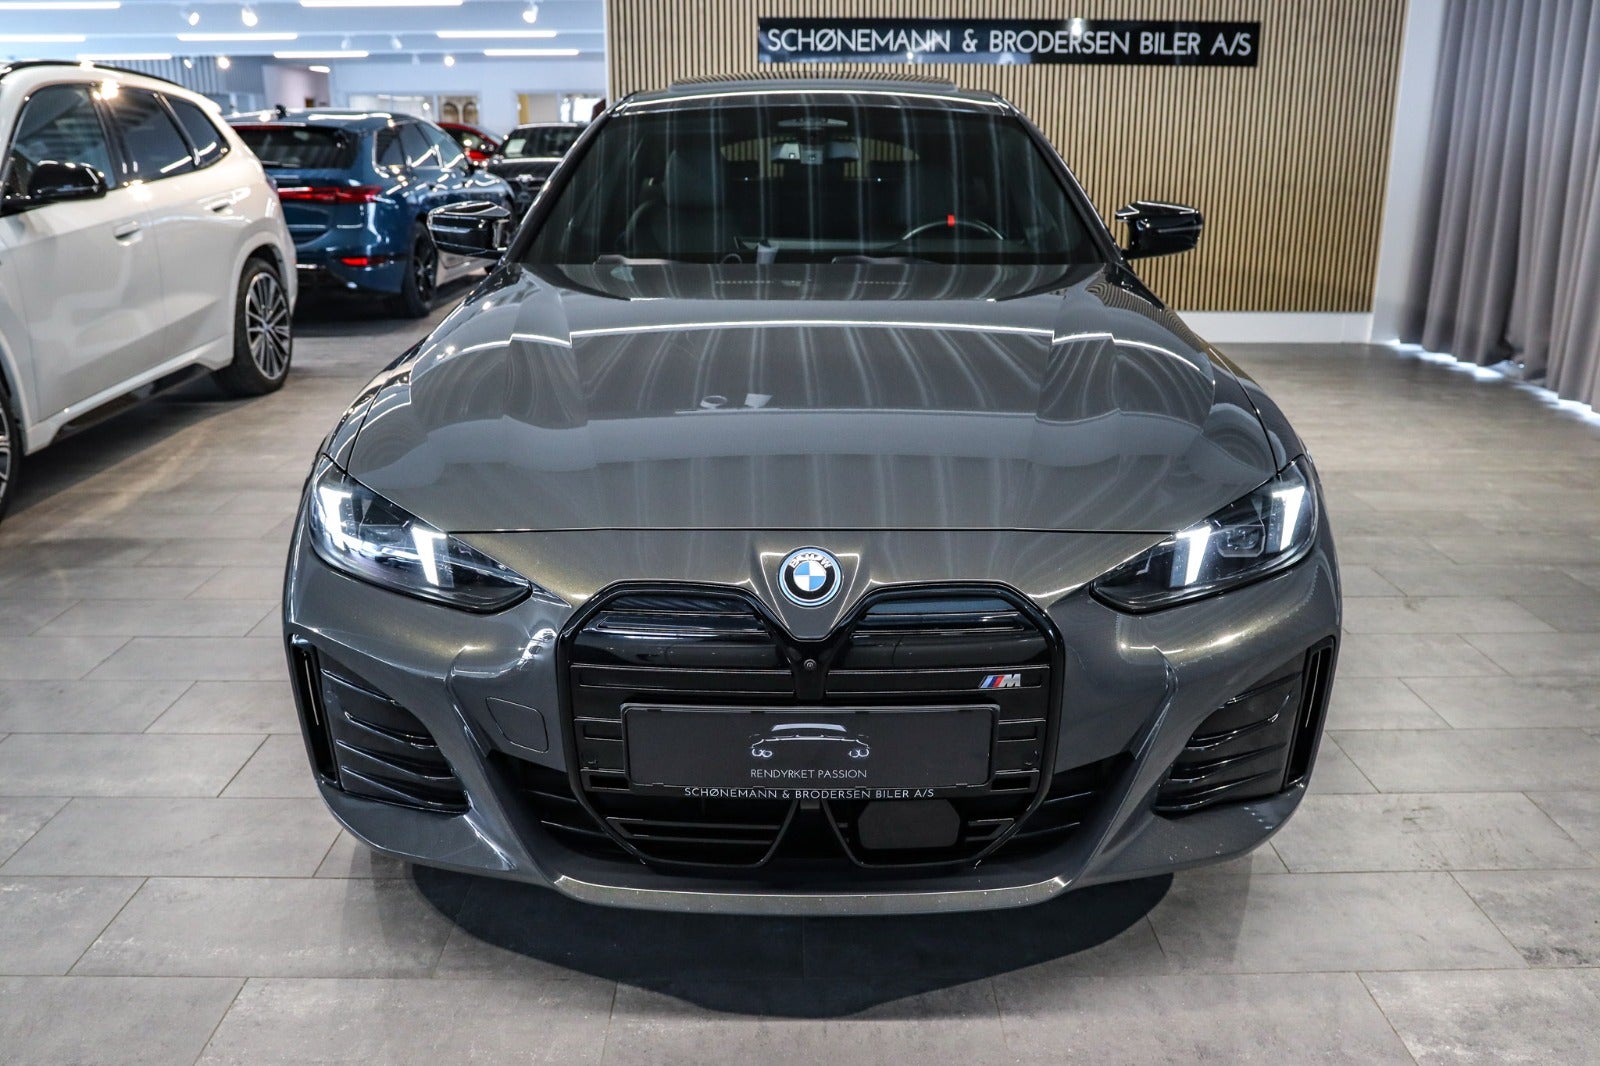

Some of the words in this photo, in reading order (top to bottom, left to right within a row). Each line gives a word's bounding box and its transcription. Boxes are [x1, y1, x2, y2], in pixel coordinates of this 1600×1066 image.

[767, 28, 951, 52] SCHØNEMANN
[961, 28, 978, 52] &
[989, 30, 1130, 54] BRODERSEN
[1139, 32, 1201, 55] BILER
[1209, 32, 1252, 56] A/S
[789, 552, 832, 569] BMW
[750, 768, 815, 779] RENDYRKET
[817, 768, 867, 779] PASSION
[684, 787, 777, 799] SCHØNEMANN
[782, 789, 790, 799] &
[795, 789, 871, 799] BRODERSEN
[875, 789, 909, 798] BILER
[913, 788, 934, 798] A/S
